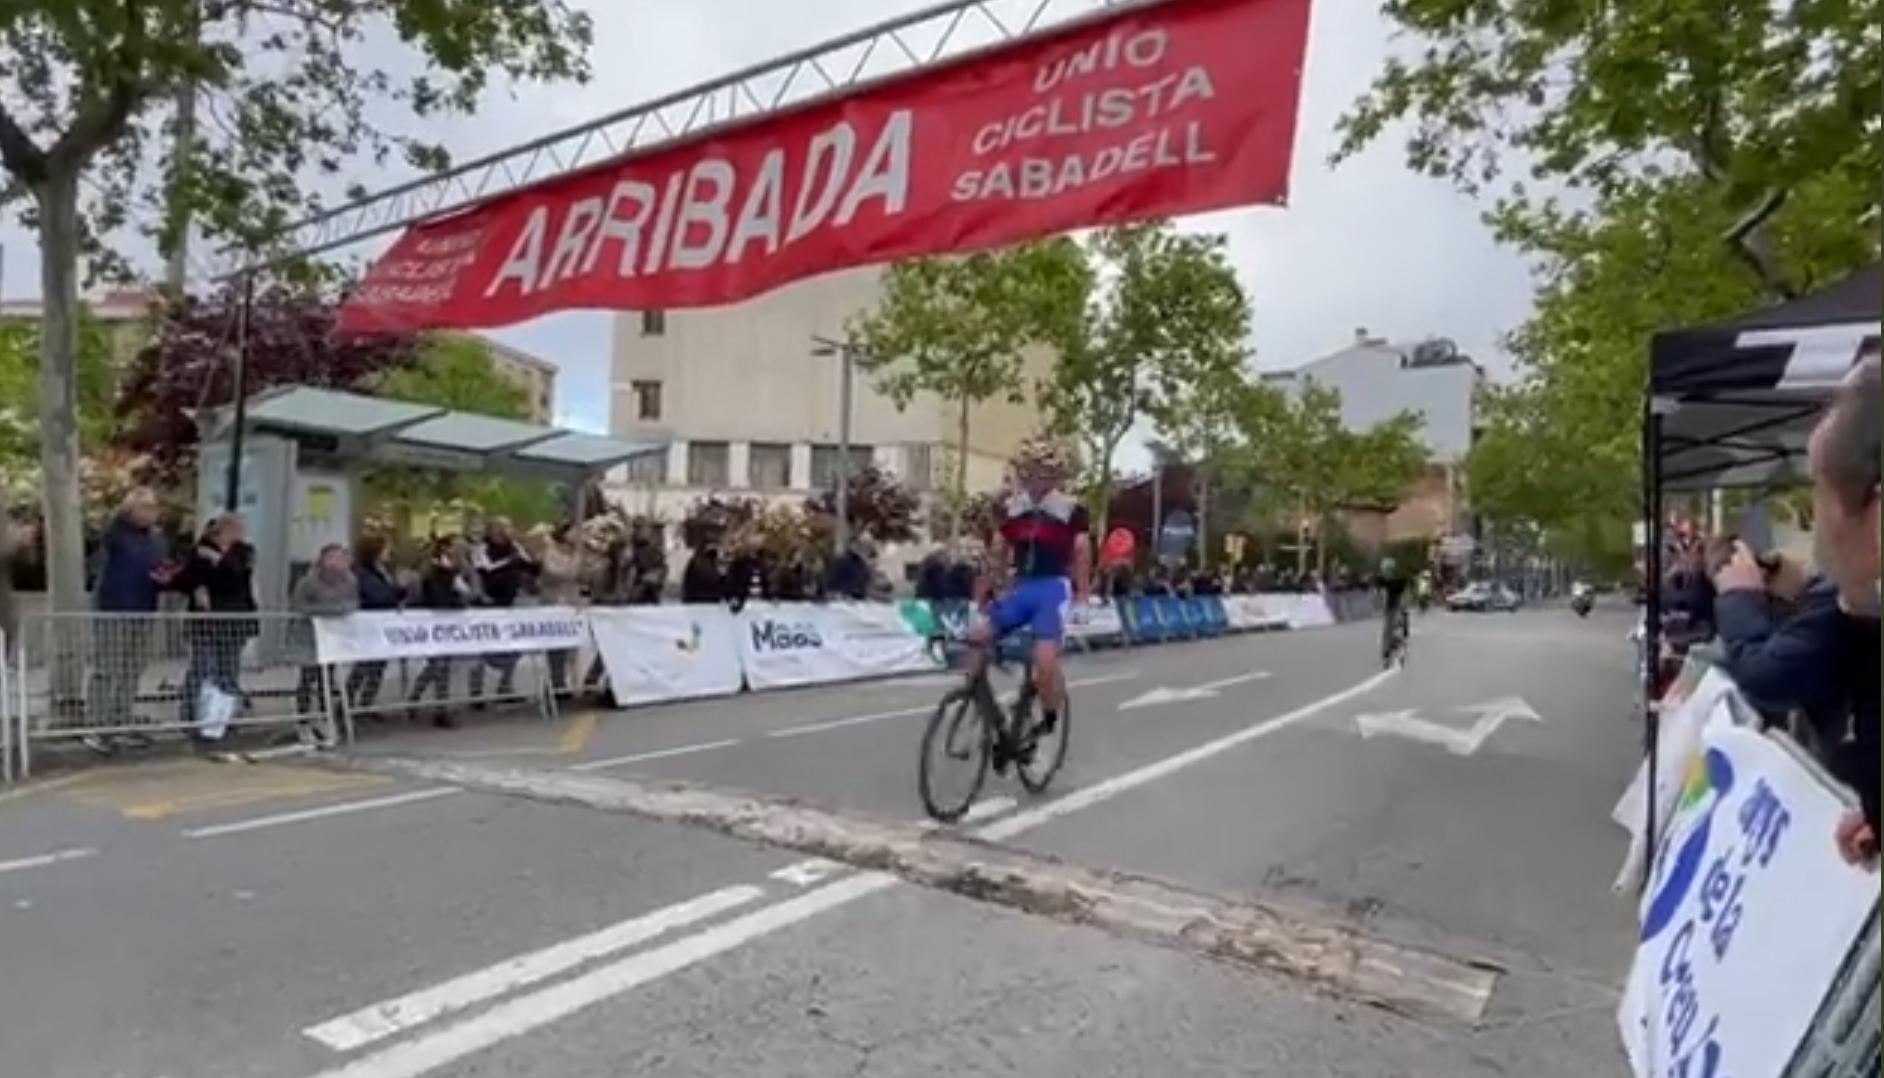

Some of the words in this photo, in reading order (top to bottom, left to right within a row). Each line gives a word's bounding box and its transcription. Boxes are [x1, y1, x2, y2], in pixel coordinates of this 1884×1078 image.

[1033, 26, 1166, 94] UNIO
[971, 65, 1214, 155] CICLISTA
[483, 110, 912, 297] ARRIBADA
[951, 123, 1216, 201] SABADELL
